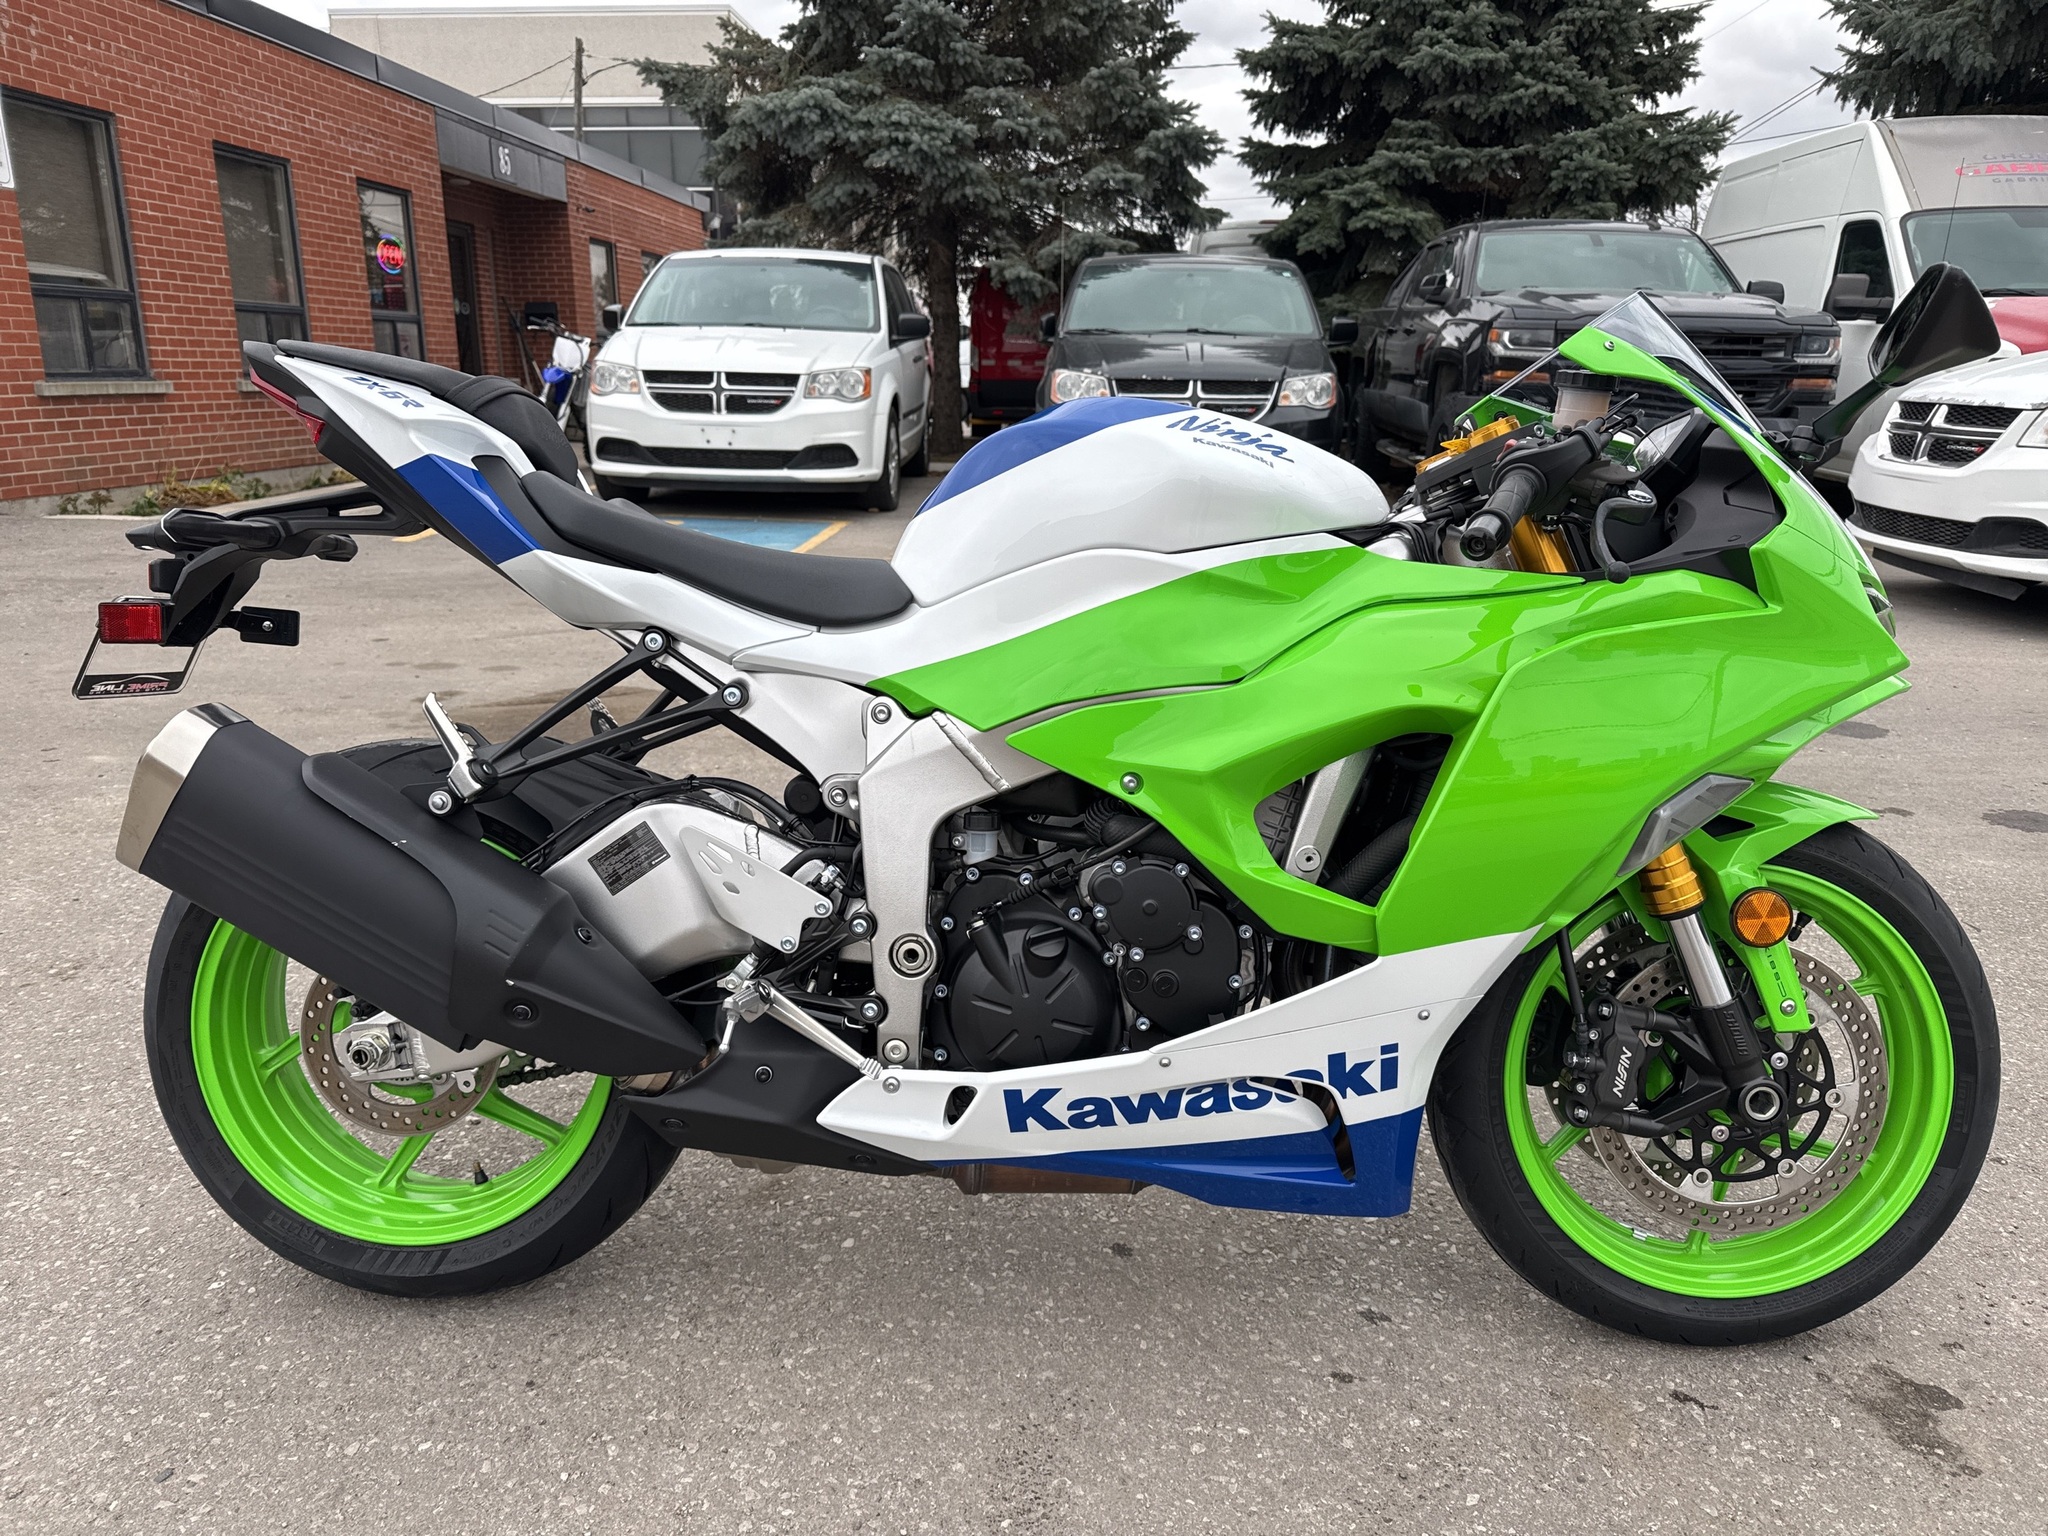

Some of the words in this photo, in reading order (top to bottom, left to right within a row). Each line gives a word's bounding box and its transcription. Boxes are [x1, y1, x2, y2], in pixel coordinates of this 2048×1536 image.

[498, 146, 511, 176] 85
[379, 242, 403, 266] OPEN
[1165, 415, 1295, 463] Ninja
[1193, 437, 1274, 468] Kawasaki
